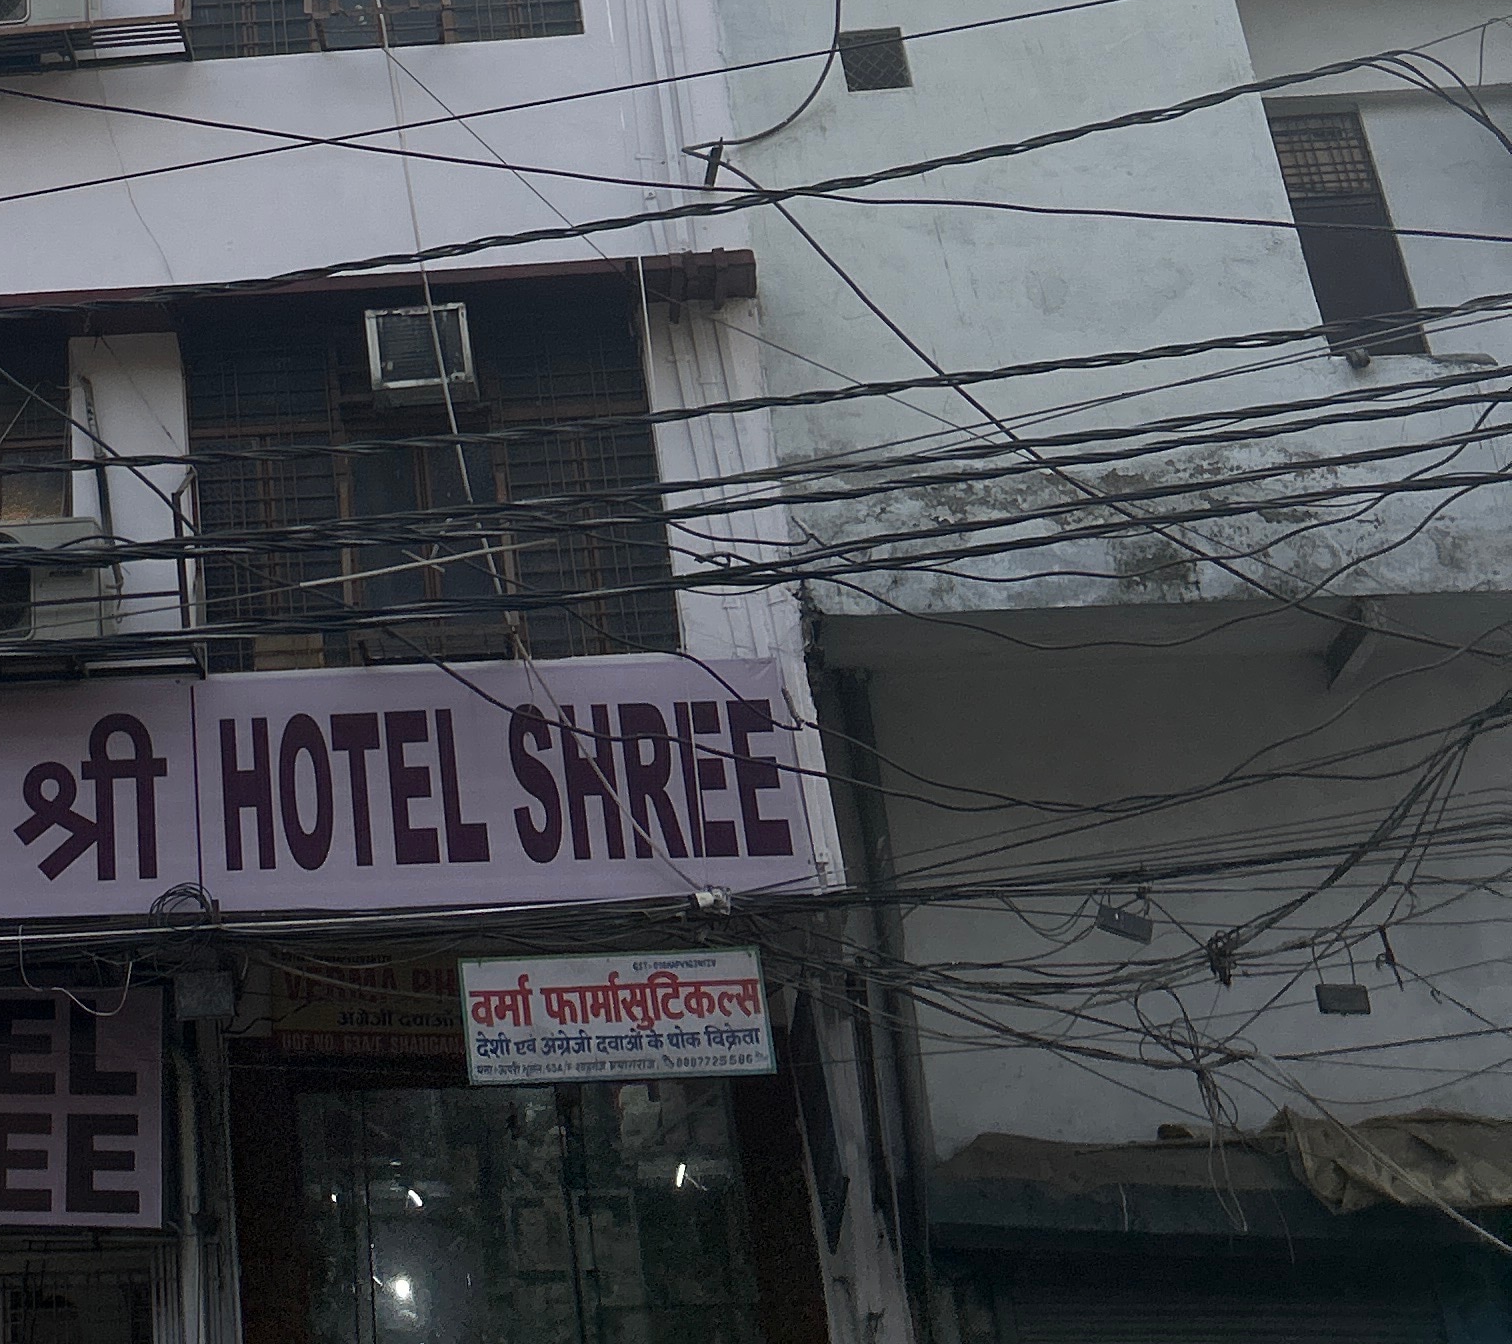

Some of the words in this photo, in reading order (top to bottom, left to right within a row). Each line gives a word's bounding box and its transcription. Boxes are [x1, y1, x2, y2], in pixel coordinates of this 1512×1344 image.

[13, 713, 167, 881] श्री
[219, 708, 490, 871] HOTEL
[509, 699, 793, 864] SHREE
[469, 974, 533, 1027] वर्मा
[476, 1031, 511, 1058] देशी
[514, 1033, 536, 1054] एवं
[541, 1029, 592, 1056] अंग्रेजी
[596, 1028, 642, 1053] दवाओं
[647, 1028, 663, 1051] के
[668, 1025, 700, 1048] थोक
[704, 1022, 760, 1052] विक्रेता
